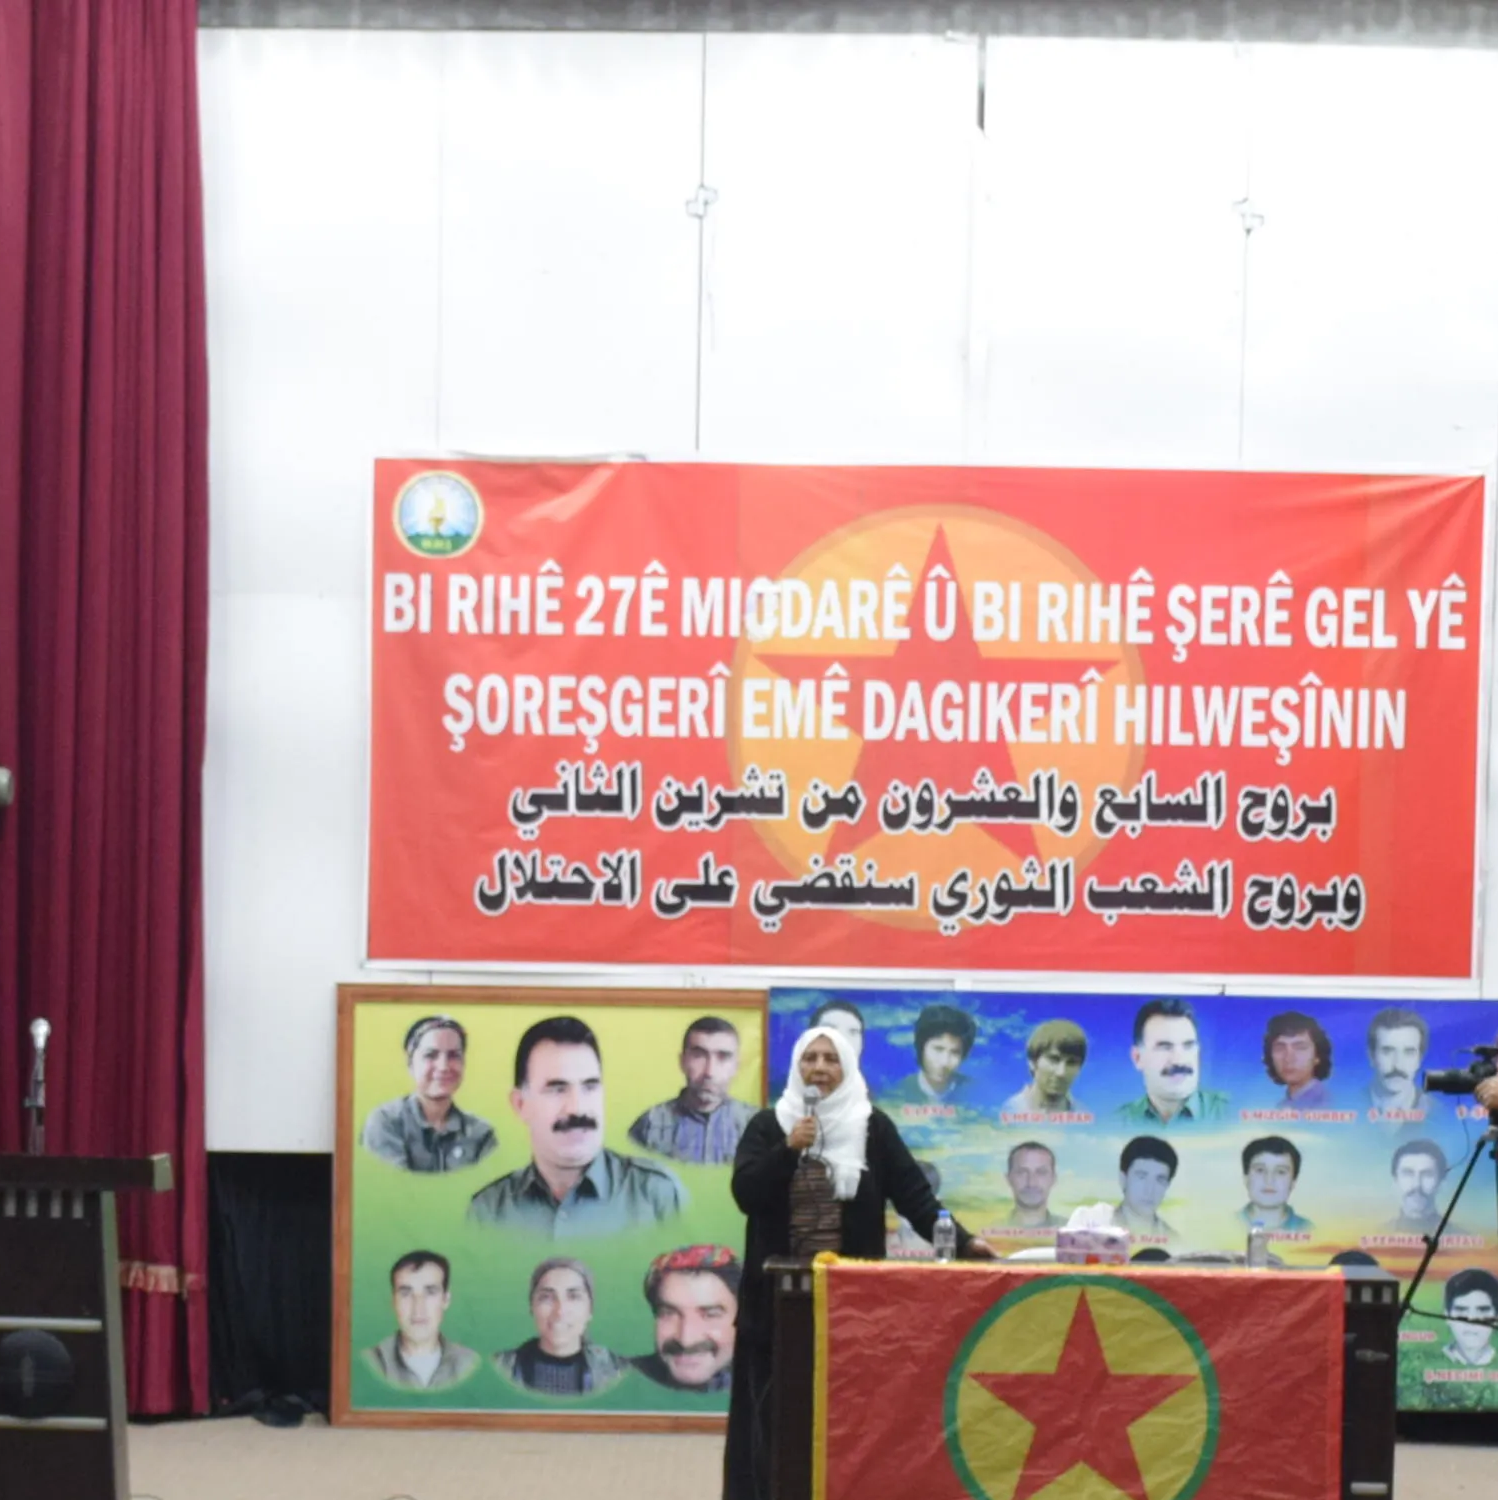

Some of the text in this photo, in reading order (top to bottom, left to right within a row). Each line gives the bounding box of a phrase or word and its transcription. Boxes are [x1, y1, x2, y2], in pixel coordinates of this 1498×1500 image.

[383, 572, 432, 633] BI
[447, 558, 564, 636] RIHÊ
[575, 559, 669, 637] 27Ê
[924, 563, 958, 641] Û
[972, 580, 1021, 643] BI
[1037, 566, 1156, 644] RIHÊ
[1165, 569, 1294, 663] ŞERÊ
[1304, 587, 1398, 650] GEL
[1406, 572, 1468, 650] YÊ
[441, 661, 1407, 767] ŞOREŞGERÎ EMÊ DAGIKERÎ HILWEŞÎNIN
[509, 760, 1338, 840] بروح السابع والعشرون من تشرين الثاني
[475, 849, 1366, 936] وبروح الشعب الثوري سنقضي على الاحتلال
